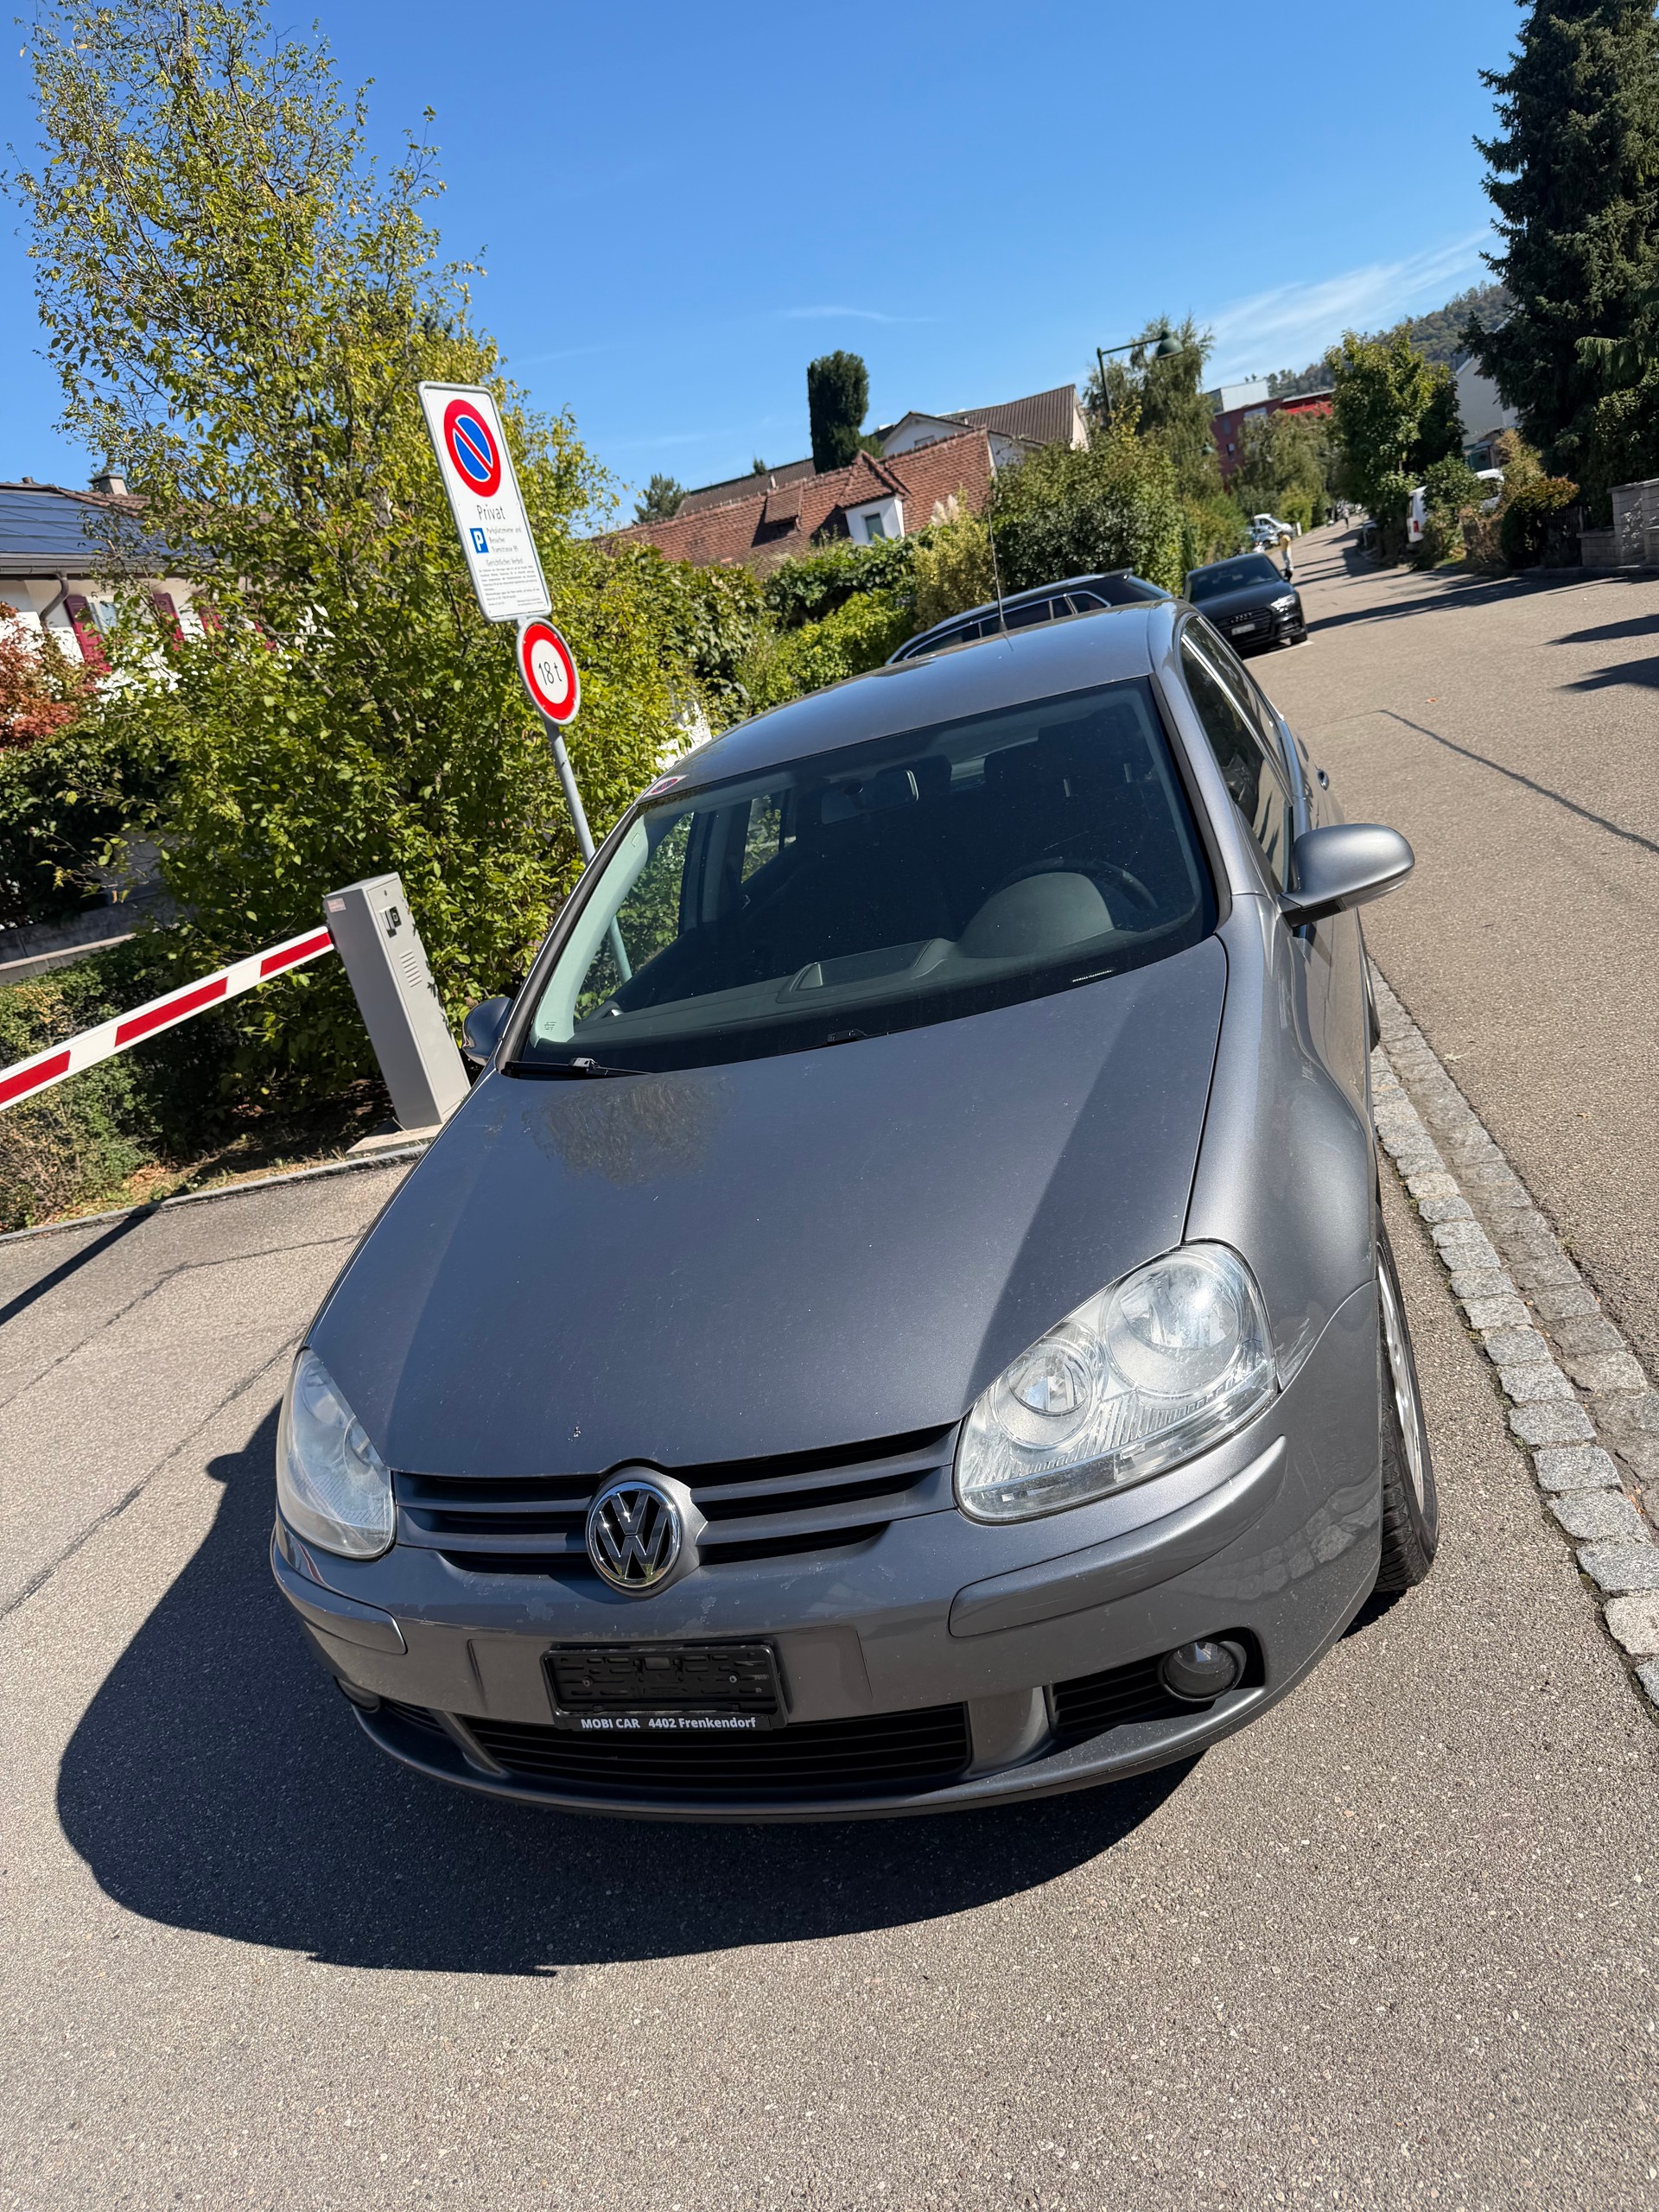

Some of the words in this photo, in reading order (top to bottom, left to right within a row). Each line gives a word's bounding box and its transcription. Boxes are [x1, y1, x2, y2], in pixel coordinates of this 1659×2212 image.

[476, 504, 506, 520] Privat
[474, 531, 484, 552] P
[538, 661, 555, 685] 18
[554, 662, 563, 682] t
[589, 1481, 681, 1587] VW
[581, 1718, 613, 1729] MOBI
[615, 1718, 641, 1729] CAR
[648, 1718, 677, 1728] 4402
[677, 1716, 756, 1728] Frenkendorf
